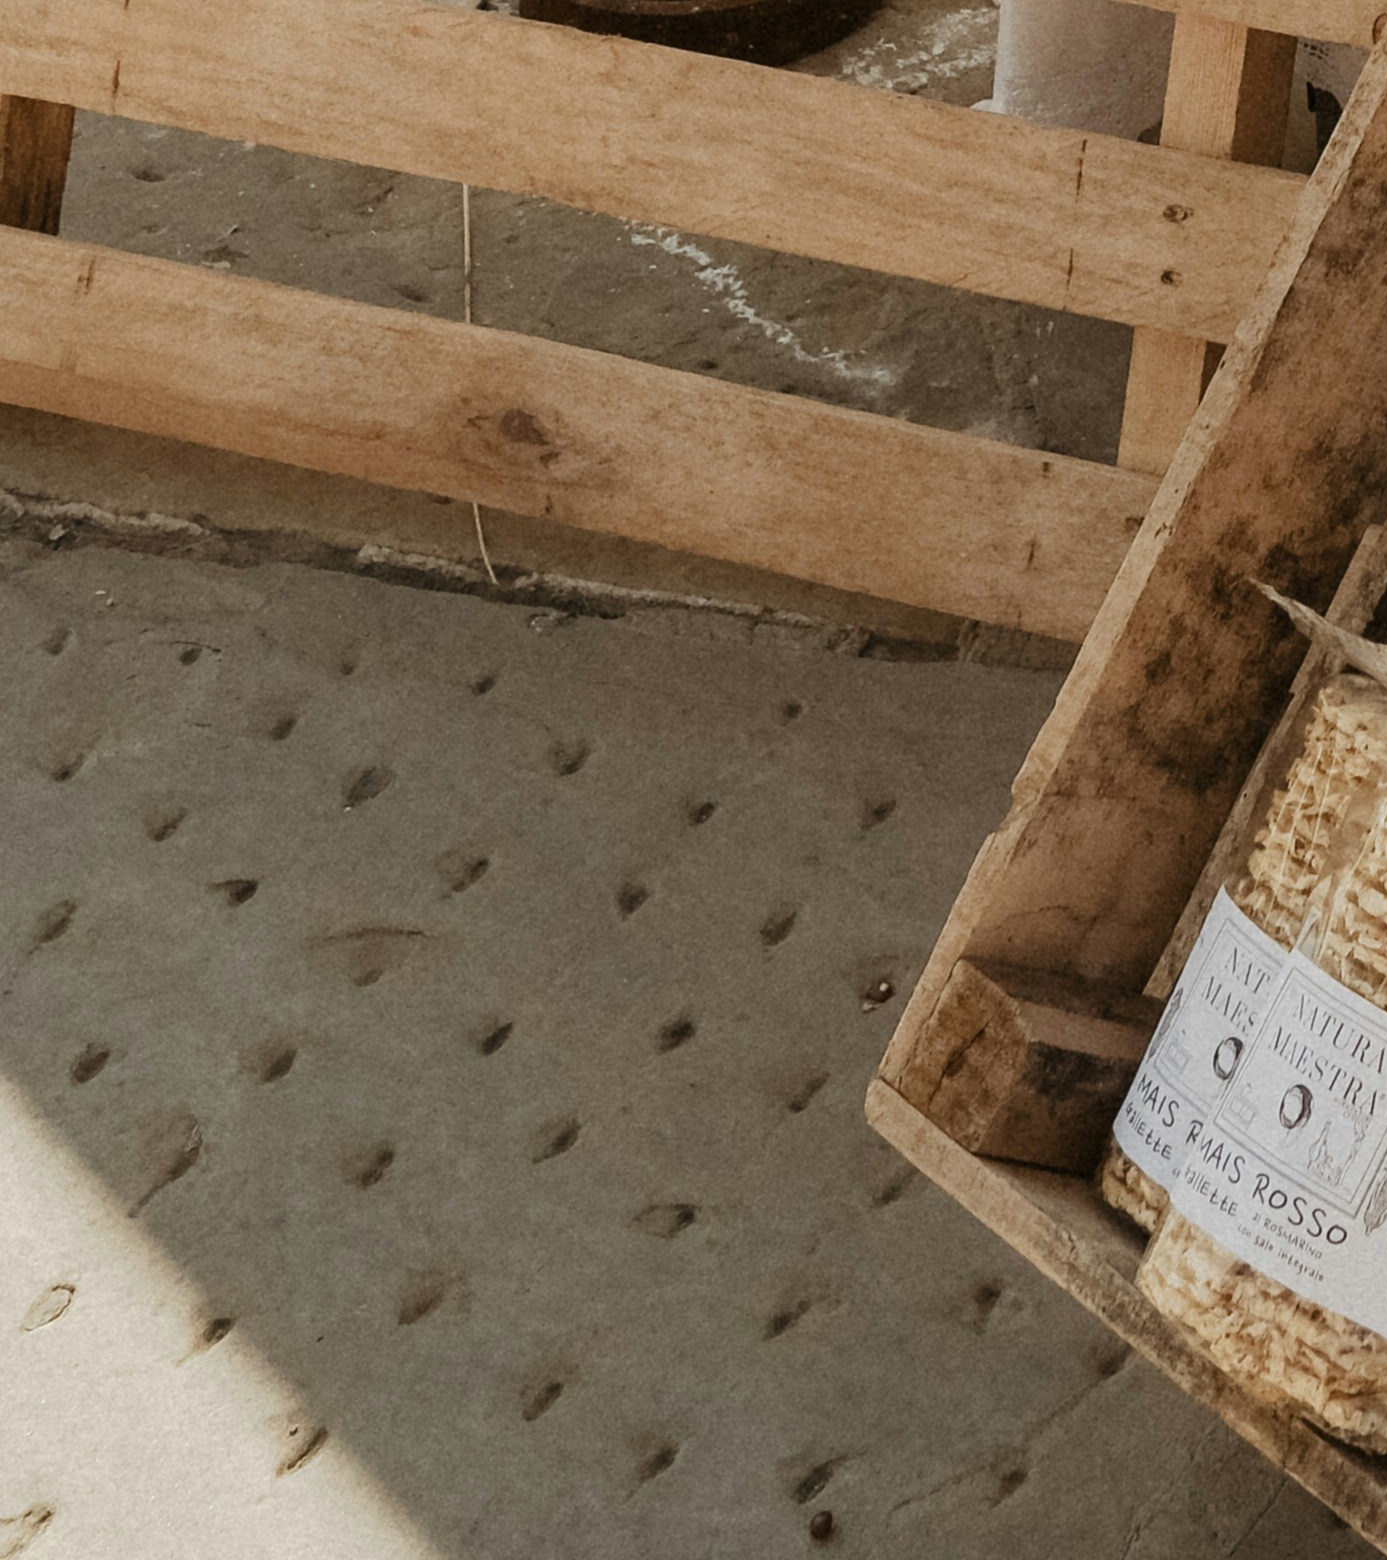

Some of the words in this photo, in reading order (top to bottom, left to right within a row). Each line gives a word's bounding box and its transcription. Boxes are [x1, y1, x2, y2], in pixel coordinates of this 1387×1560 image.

[1268, 1026, 1380, 1116] MAESTRA
[1293, 994, 1386, 1074] NATURA
[1137, 1074, 1180, 1127] MAIS
[1200, 1130, 1246, 1184] MAIS
[1252, 1173, 1348, 1245] ROSSO
